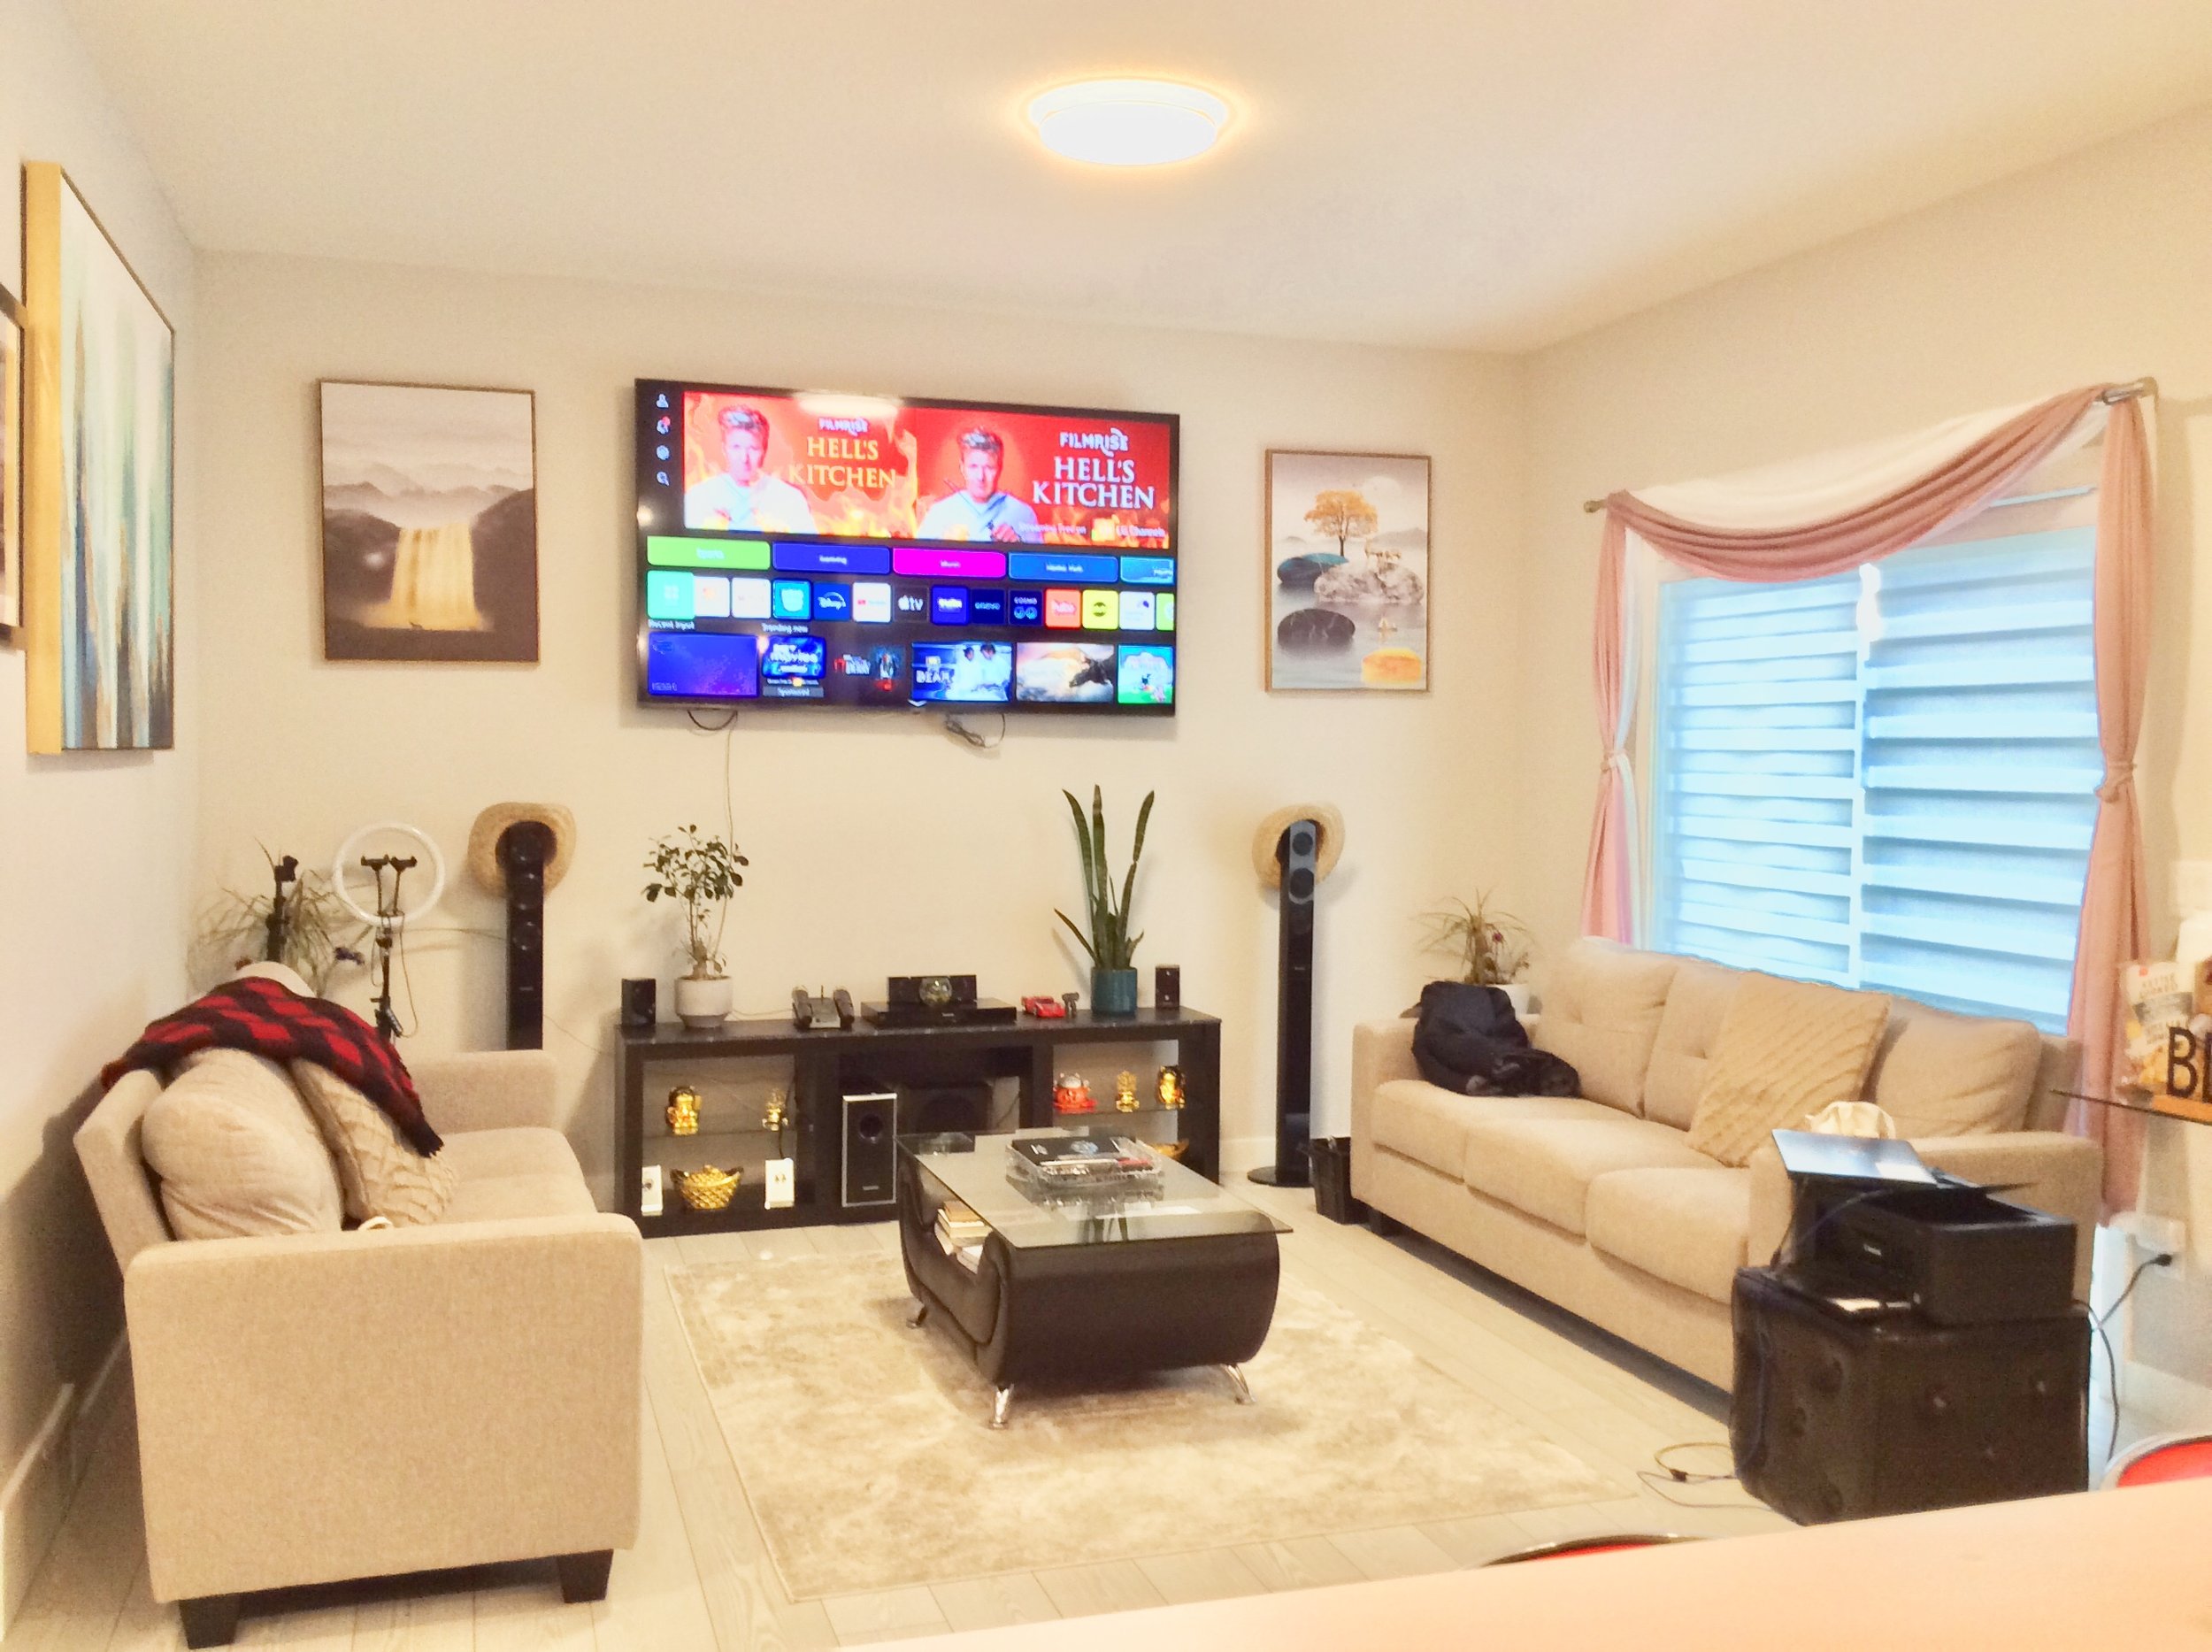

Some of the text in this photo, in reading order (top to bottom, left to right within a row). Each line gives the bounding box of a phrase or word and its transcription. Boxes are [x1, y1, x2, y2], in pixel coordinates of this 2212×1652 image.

[807, 436, 879, 460] HELL'S
[1060, 427, 1129, 457] FILMRISE
[788, 463, 895, 488] KITCHEN
[1054, 457, 1135, 483] HELL'S
[1033, 480, 1155, 510] KITCHEN
[2166, 1026, 2212, 1103] B
